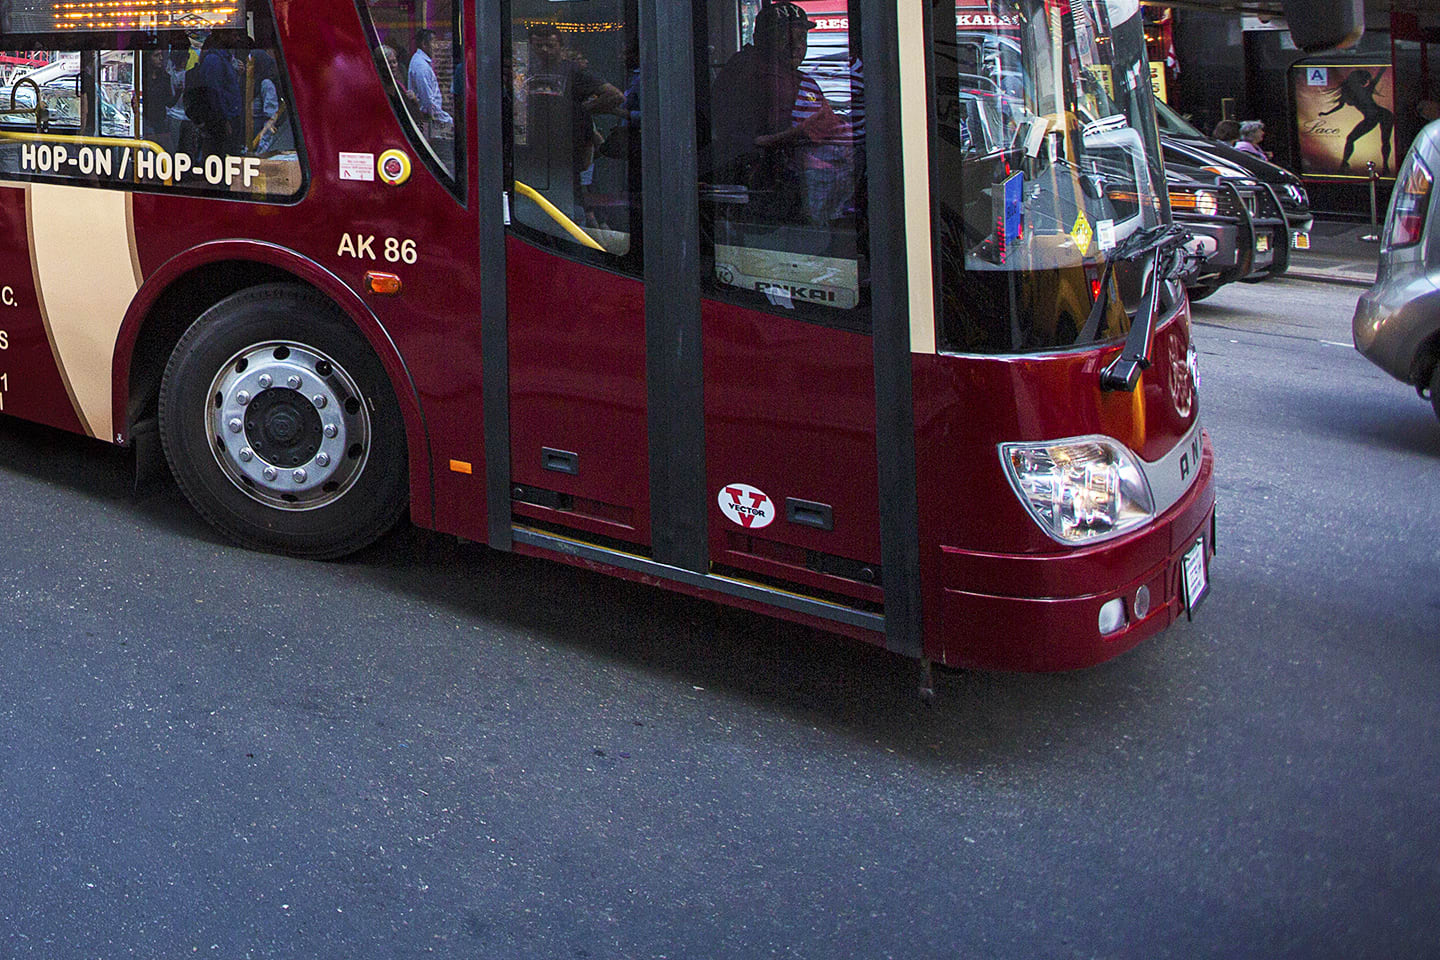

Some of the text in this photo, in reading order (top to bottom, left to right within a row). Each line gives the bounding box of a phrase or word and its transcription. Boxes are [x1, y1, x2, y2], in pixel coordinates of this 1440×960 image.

[1311, 69, 1324, 81] A
[1303, 119, 1340, 135] Lace
[22, 143, 112, 177] HOP-ON
[137, 150, 261, 188] HOP-OFF
[337, 232, 418, 265] AK 86
[728, 502, 766, 518] VECTOR
